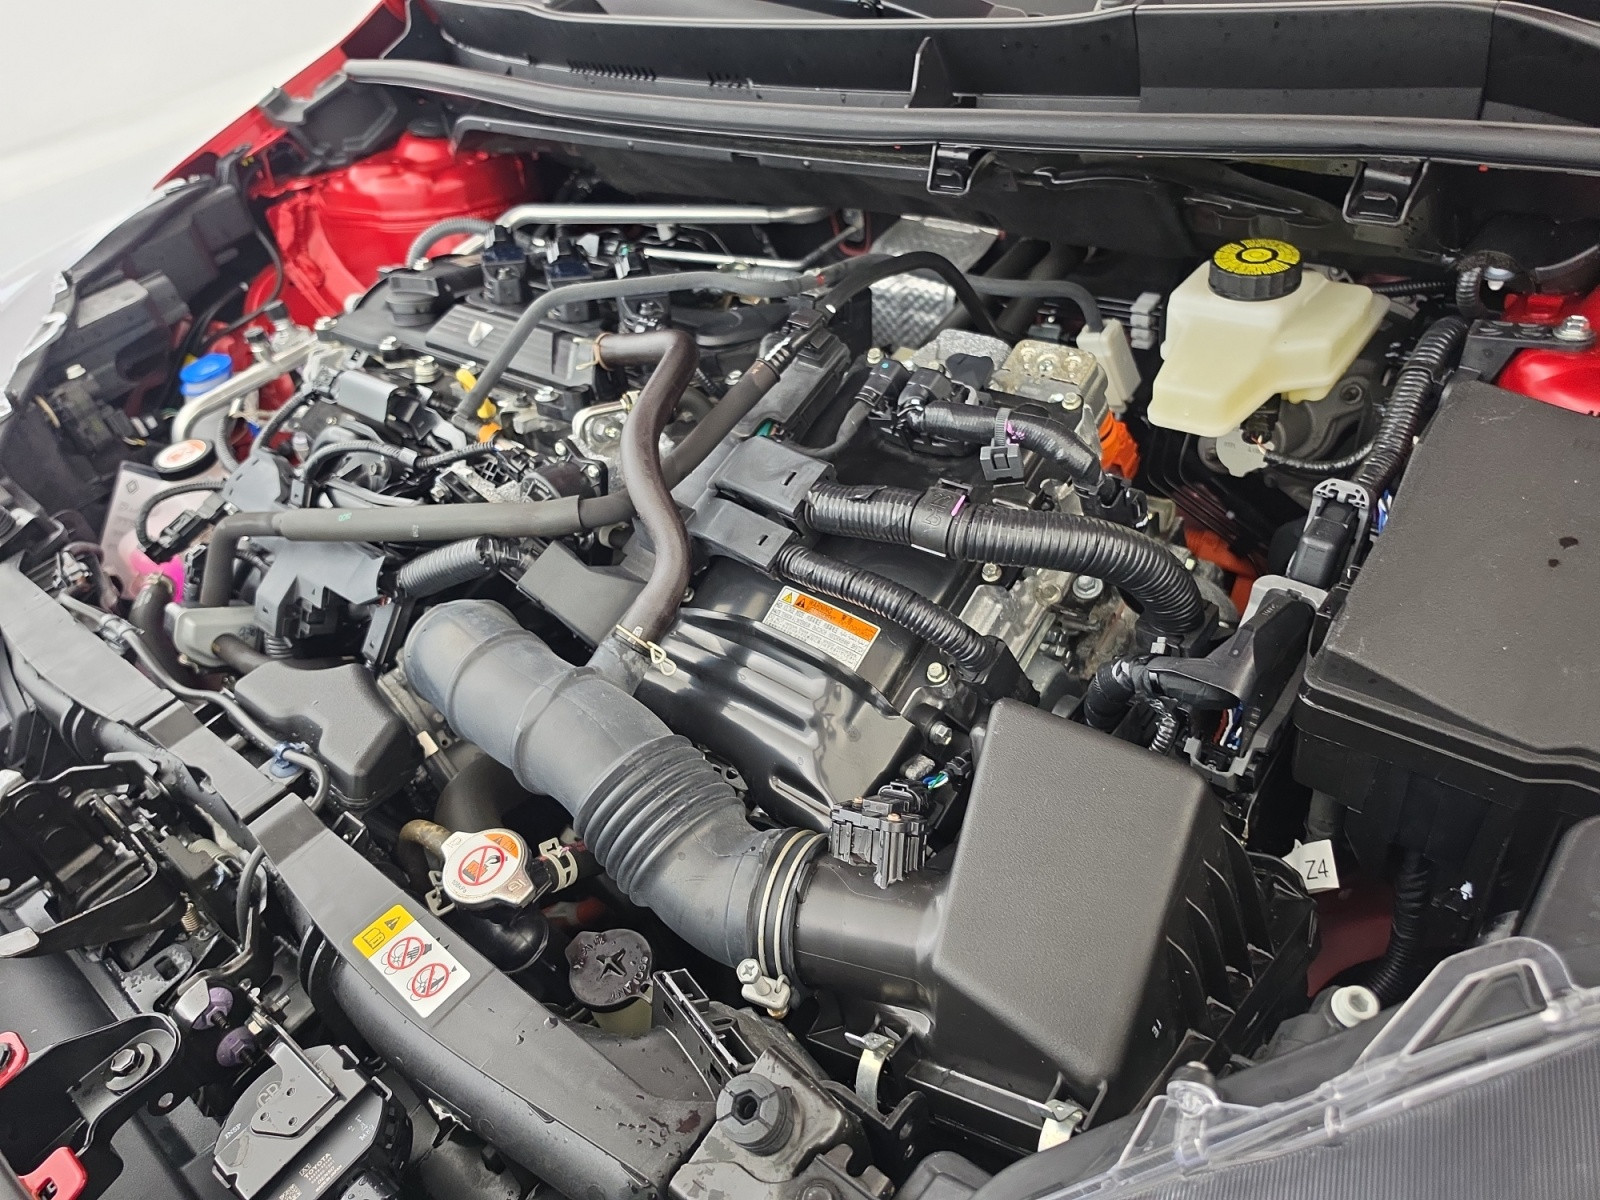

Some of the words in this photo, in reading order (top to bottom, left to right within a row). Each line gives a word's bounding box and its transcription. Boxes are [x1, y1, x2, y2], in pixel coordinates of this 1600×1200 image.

[1304, 858, 1329, 880] Z4
[302, 1152, 331, 1178] TOYOTA
[316, 1164, 335, 1185] DENSO
